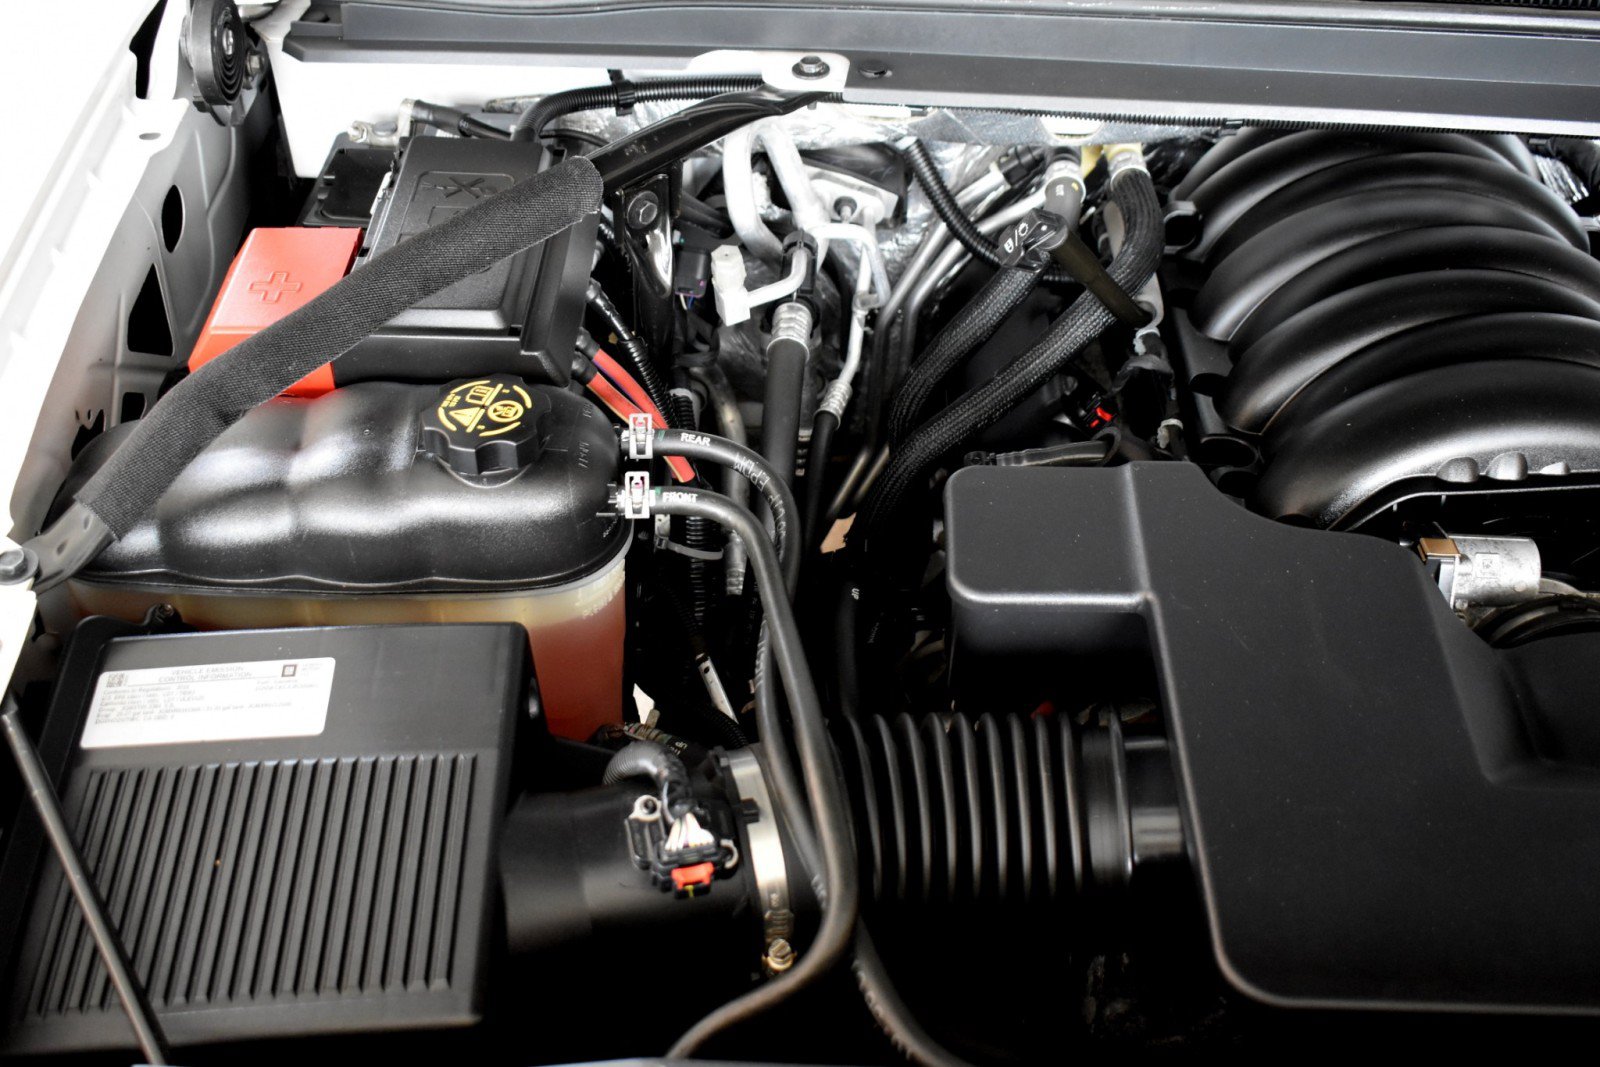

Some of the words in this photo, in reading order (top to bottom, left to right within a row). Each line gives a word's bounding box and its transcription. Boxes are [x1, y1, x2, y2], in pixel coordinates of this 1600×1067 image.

[680, 432, 711, 447] REAR
[662, 491, 698, 503] FRONT
[158, 674, 194, 683] CONTROL
[198, 671, 252, 681] INFORMATION
